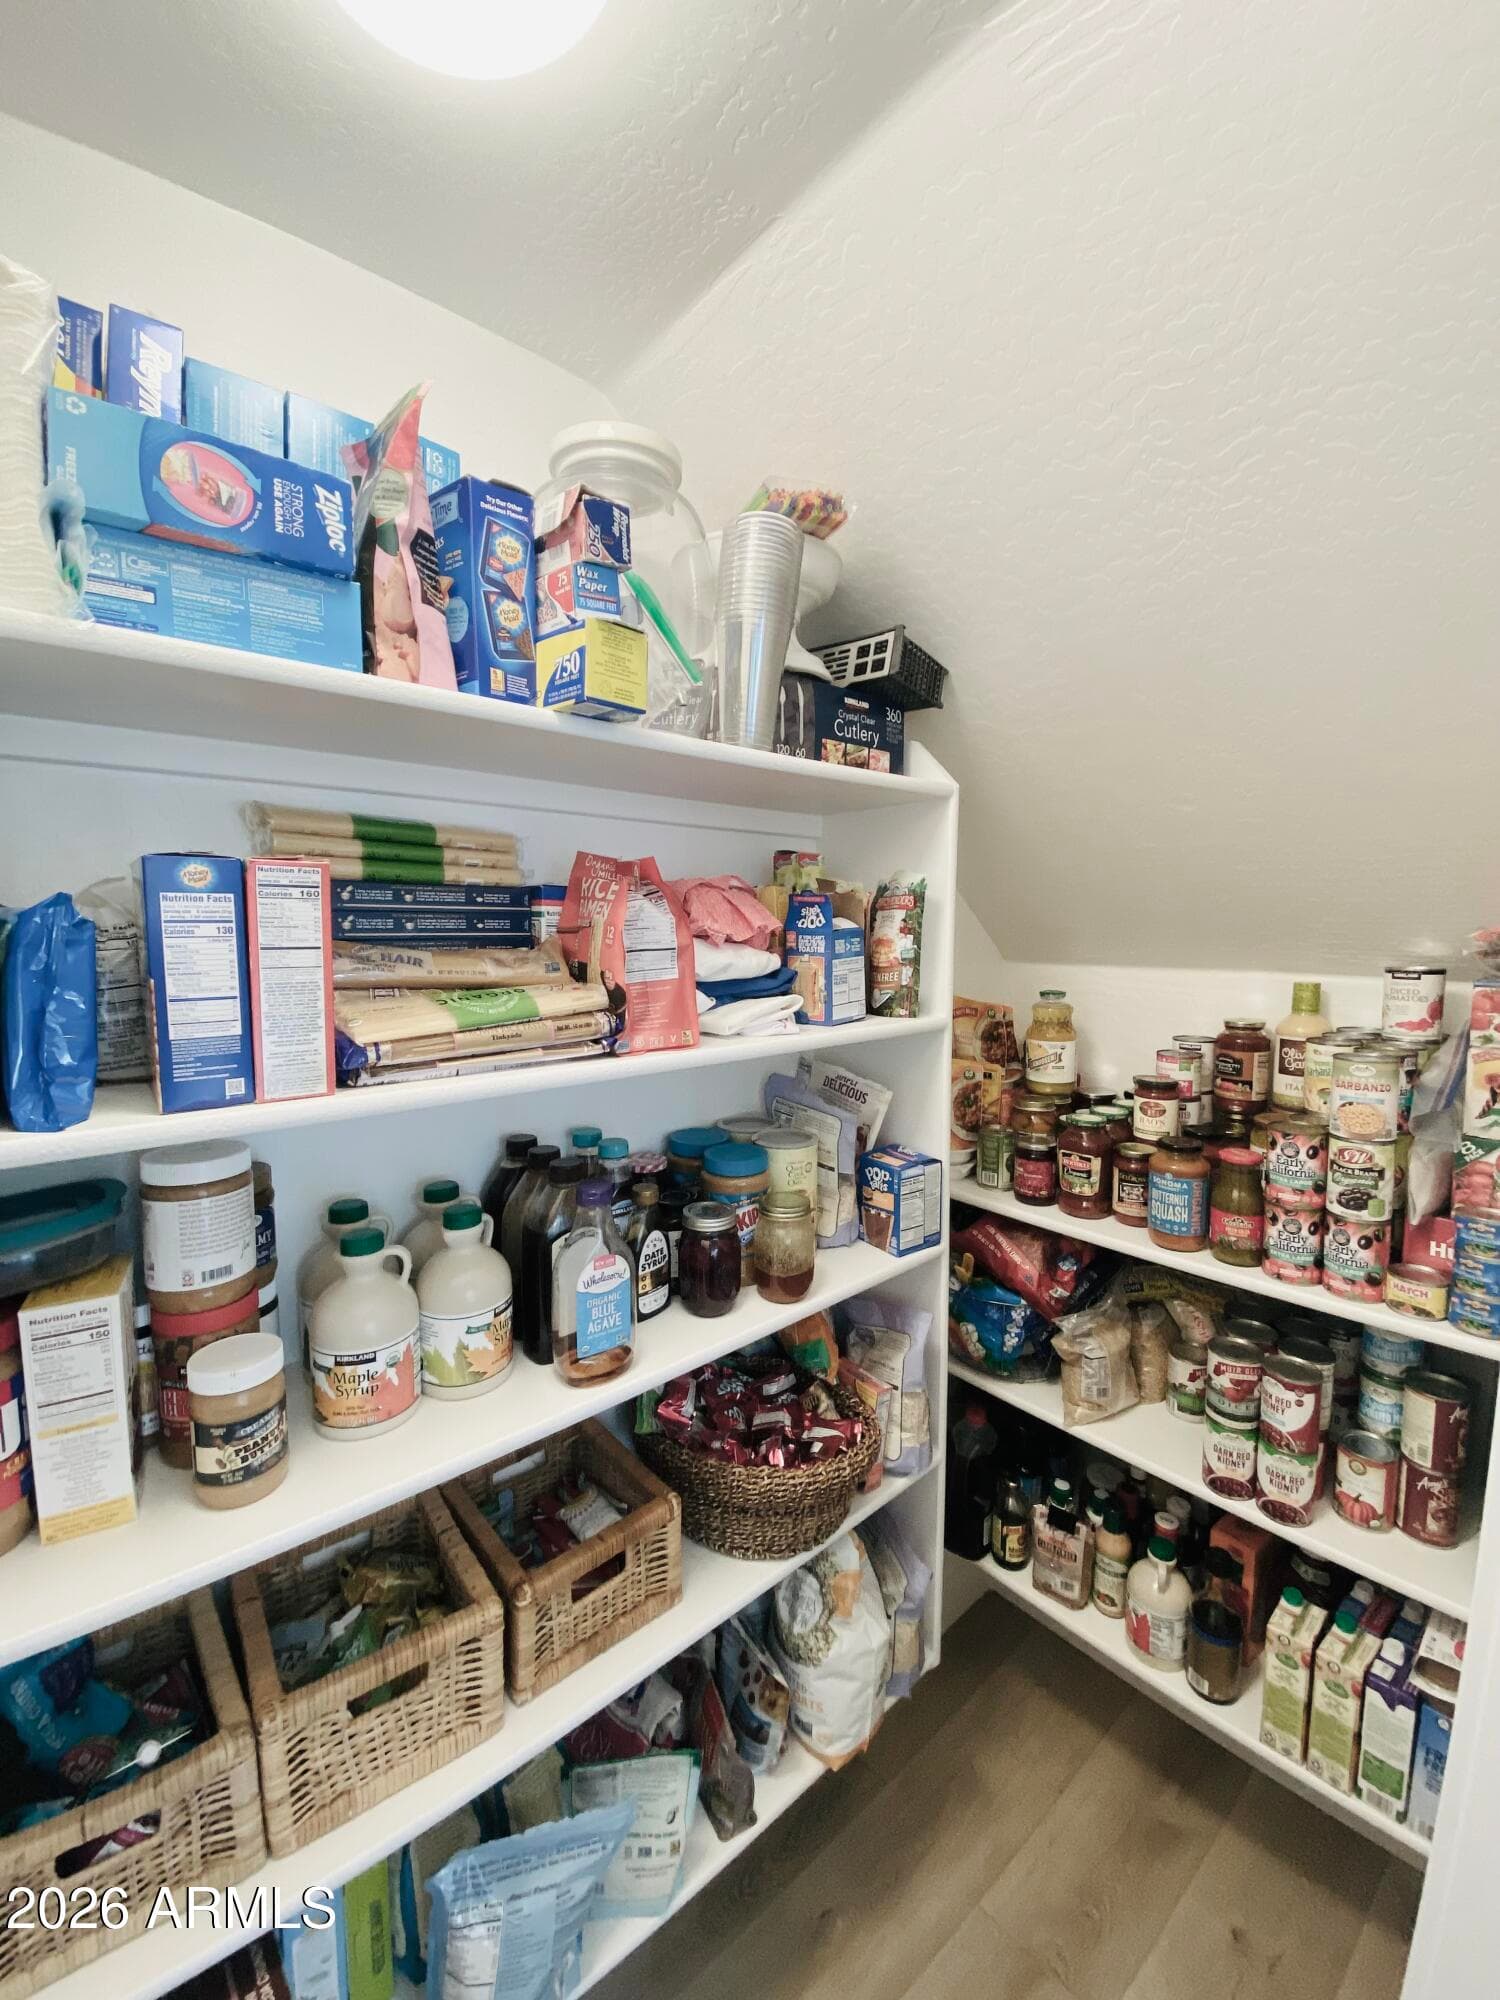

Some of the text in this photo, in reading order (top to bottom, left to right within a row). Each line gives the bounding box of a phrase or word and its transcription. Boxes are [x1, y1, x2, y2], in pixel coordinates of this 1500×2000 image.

[273, 478, 285, 534] USE AGAIN
[282, 480, 294, 535] ENOUGH TO
[290, 483, 305, 538] STRONG
[313, 483, 347, 554] Ziploc
[611, 505, 622, 538] Wrap
[616, 510, 631, 563] Reynolds
[557, 570, 568, 588] 75
[576, 565, 599, 580] Wax
[578, 578, 608, 593] Paper
[586, 598, 605, 610] SQUARE
[606, 601, 617, 612] FEET
[554, 651, 580, 681] 750
[652, 710, 700, 730] Cutlery
[885, 706, 903, 724] 360
[833, 718, 880, 749] Cutlery
[795, 747, 807, 758] 60
[257, 865, 321, 876] Nutrition Facts
[257, 889, 321, 899] Calories 160
[581, 876, 621, 899] RICE
[161, 893, 233, 904] Nutrition Facts
[163, 926, 234, 936] Calories 130
[606, 925, 616, 940] 12
[380, 952, 425, 968] HAIR
[881, 971, 900, 983] FREE
[822, 1074, 869, 1105] DELICIOUS
[1334, 1080, 1392, 1093] GARBANZO
[1460, 1140, 1476, 1156] 8
[1276, 1153, 1306, 1169] Early
[1267, 1163, 1316, 1180] California
[1152, 1175, 1188, 1190] SONOMA
[1150, 1188, 1189, 1207] BUTTERNUT
[1150, 1200, 1189, 1224] SQUASH
[1267, 1235, 1321, 1254] California
[1277, 1229, 1309, 1246] Early
[643, 1246, 665, 1263] DATE
[1328, 1240, 1358, 1258] Early
[640, 1257, 668, 1273] SYRUP
[1392, 1280, 1430, 1299] HATCH
[586, 1290, 622, 1309] ORGANIC
[28, 1305, 109, 1327] Nutrition Facts
[591, 1301, 617, 1319] BLUE
[586, 1312, 623, 1335] AGAVE
[31, 1328, 110, 1352] Calories 150
[333, 1368, 379, 1389] Maple
[334, 1383, 379, 1400] Syrup
[1212, 1443, 1251, 1461] DARK RED
[1216, 1455, 1247, 1470] KIDNEY
[1265, 1465, 1306, 1486] DARK RED
[1268, 1477, 1300, 1495] KIDNEY
